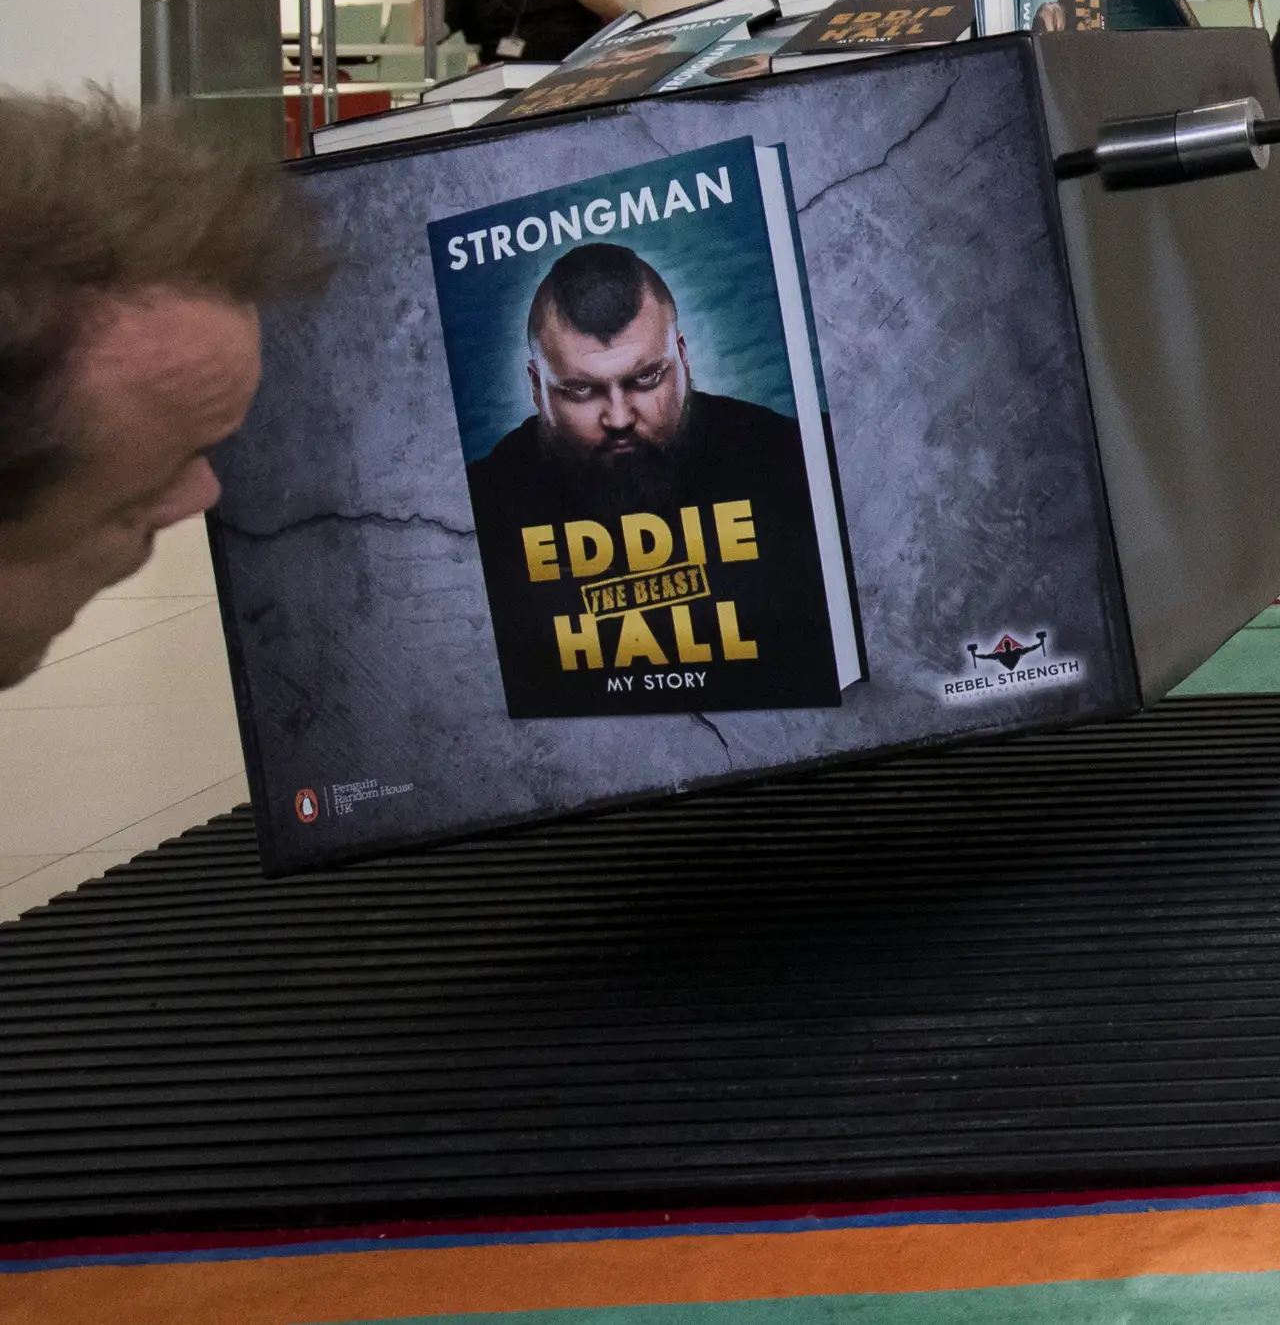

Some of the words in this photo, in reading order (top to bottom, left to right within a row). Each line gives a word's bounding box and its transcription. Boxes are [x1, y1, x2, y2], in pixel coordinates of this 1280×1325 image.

[827, 5, 955, 25] EDDIE
[659, 43, 736, 92] TRONGMAN
[447, 166, 733, 270] STRONGMAN
[521, 499, 759, 583] EDDIE
[590, 584, 627, 614] THE
[633, 567, 700, 604] BEAST
[553, 600, 758, 671] HALL
[607, 675, 634, 693] MY
[644, 671, 707, 690] STORY
[944, 676, 994, 695] REBEL
[997, 660, 1080, 686] STRENGTH
[332, 778, 378, 795] Penguin
[334, 788, 379, 805] Random
[380, 782, 414, 796] House
[335, 802, 354, 815] UK
